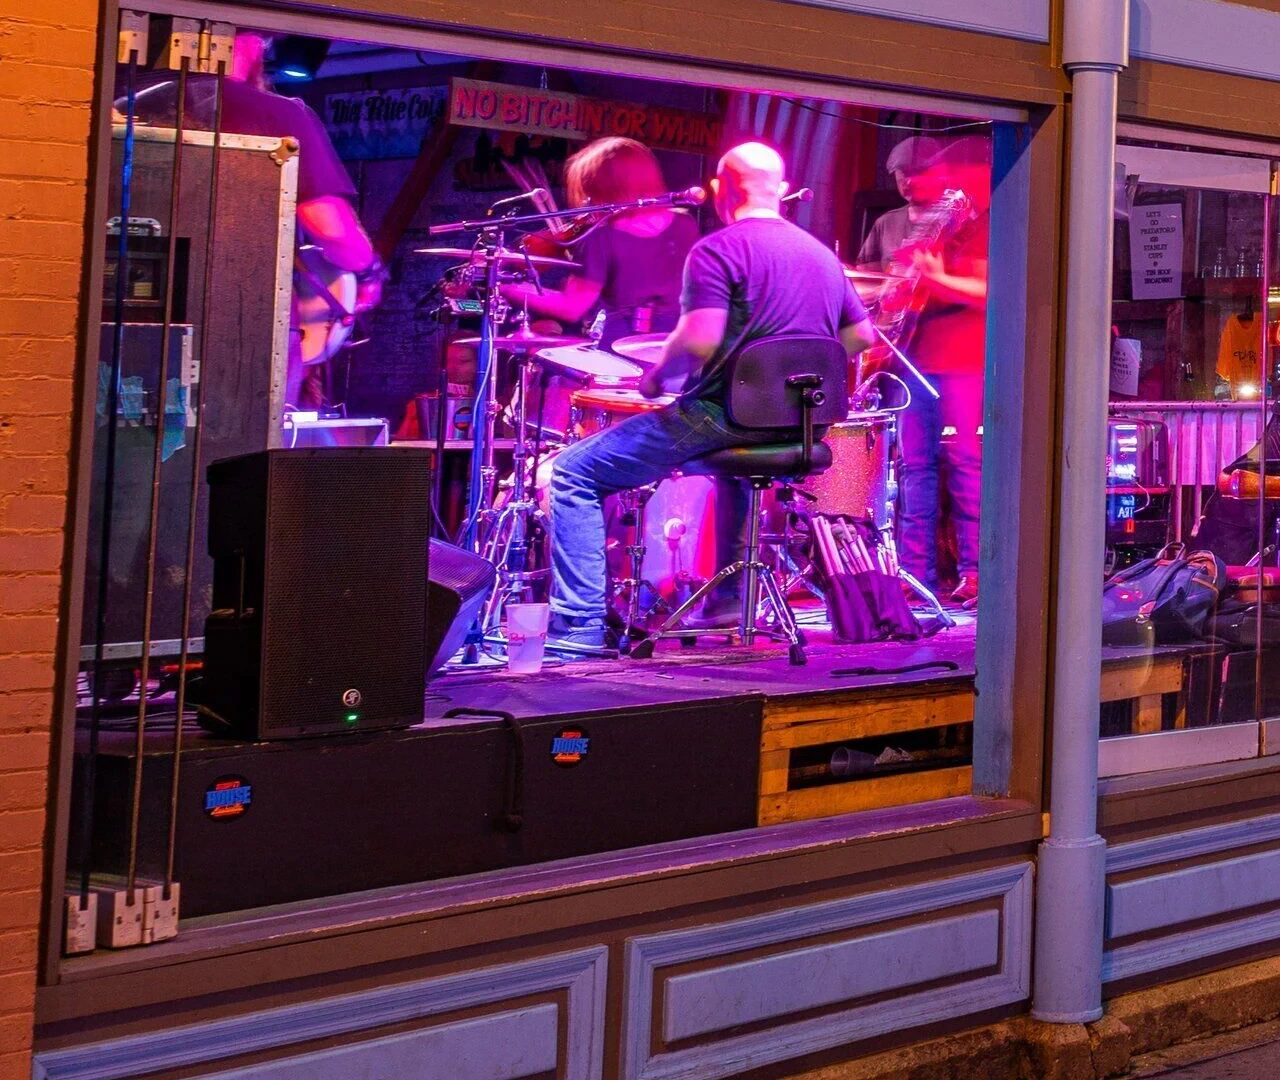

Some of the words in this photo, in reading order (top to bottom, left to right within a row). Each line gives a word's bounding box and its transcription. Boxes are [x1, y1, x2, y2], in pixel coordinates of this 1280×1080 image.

[454, 86, 498, 121] NO
[502, 91, 611, 134] BITCHIN'
[612, 107, 648, 137] OR
